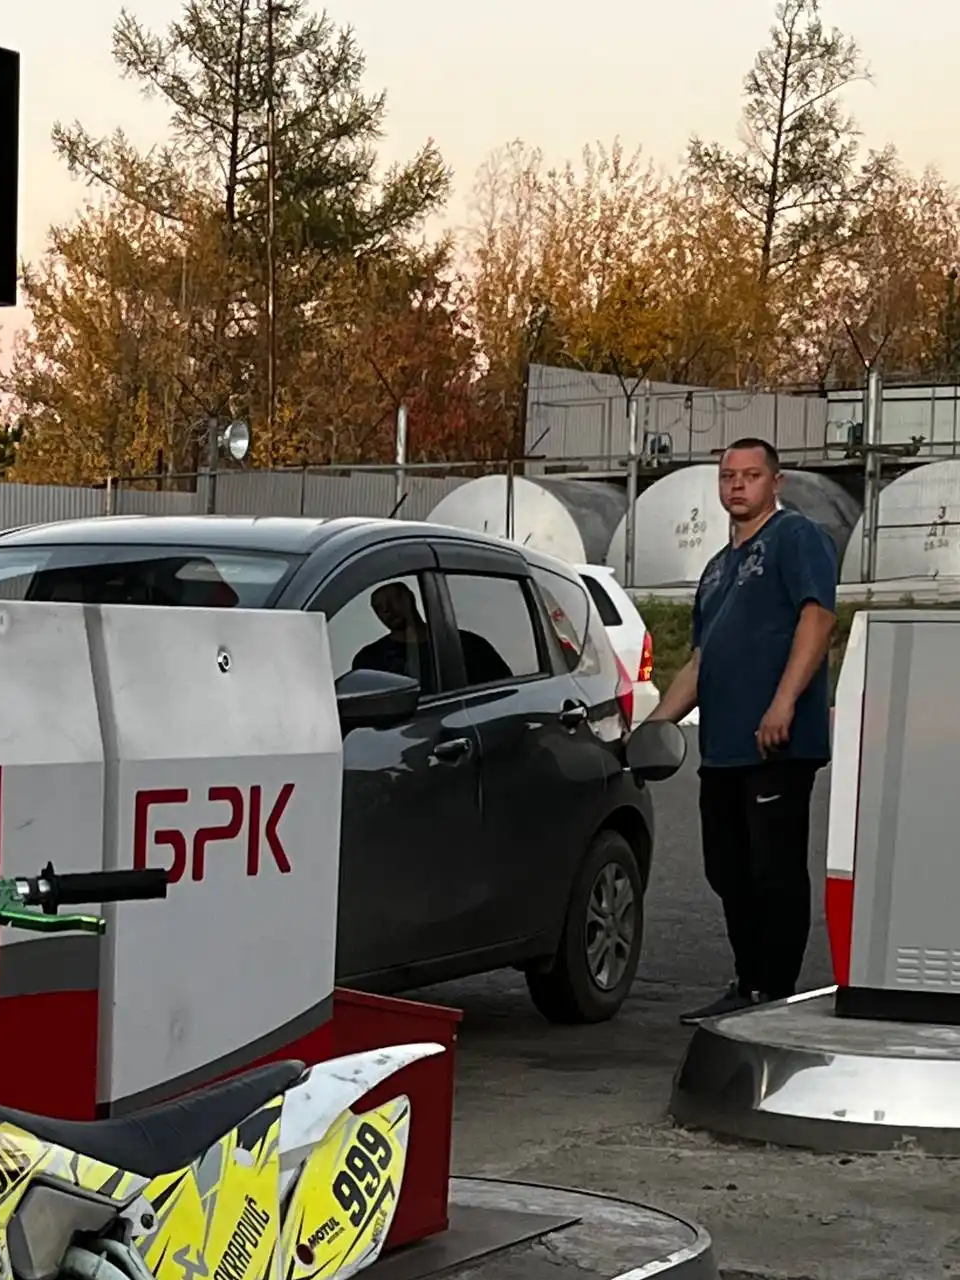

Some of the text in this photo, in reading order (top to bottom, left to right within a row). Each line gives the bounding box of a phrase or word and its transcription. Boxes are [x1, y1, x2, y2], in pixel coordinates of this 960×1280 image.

[690, 507, 699, 522] 2
[938, 505, 947, 520] 3
[133, 783, 296, 885] БРК
[332, 1121, 393, 1228] 999
[307, 1216, 341, 1249] MOTUL
